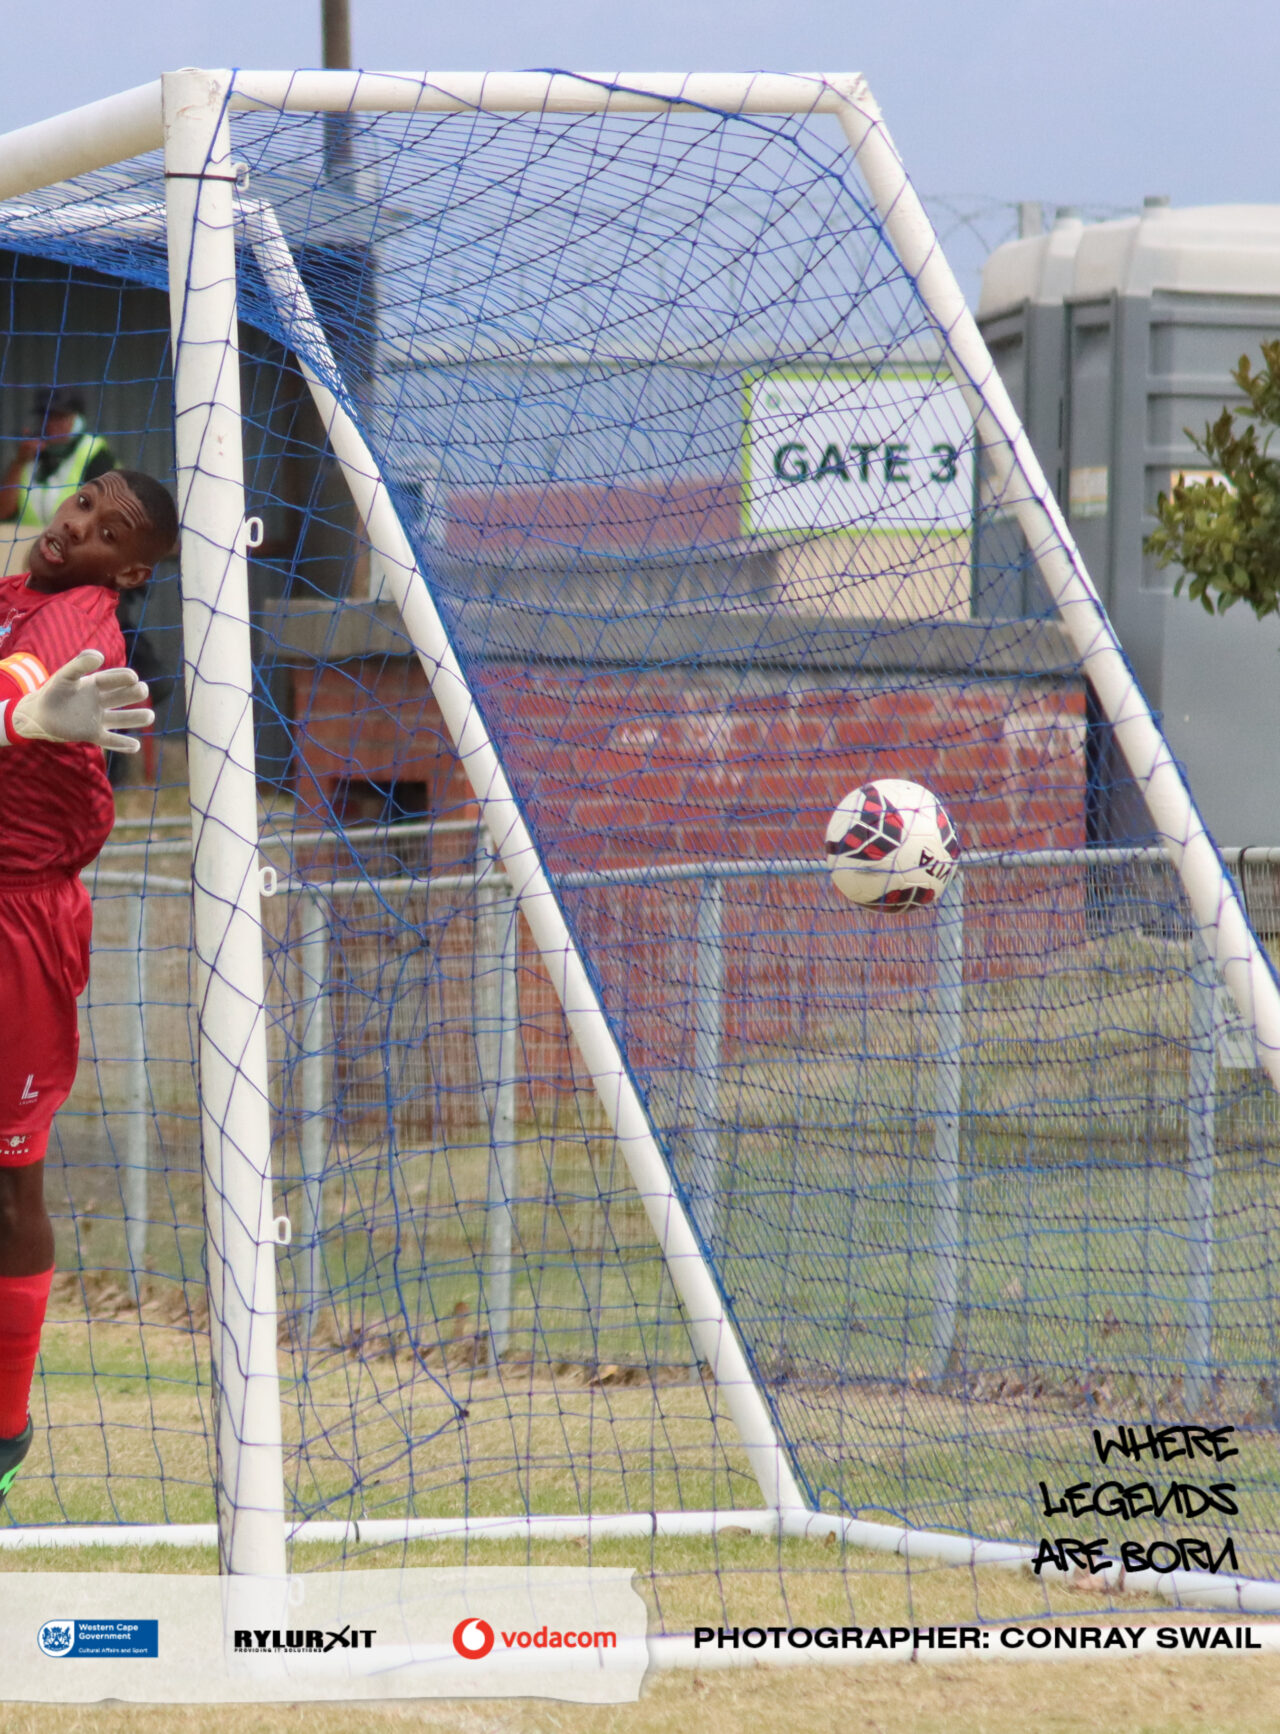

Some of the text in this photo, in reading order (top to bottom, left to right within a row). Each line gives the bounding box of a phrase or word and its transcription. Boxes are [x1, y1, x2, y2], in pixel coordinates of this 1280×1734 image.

[773, 442, 958, 483] GATE 3
[21, 1073, 39, 1100] L
